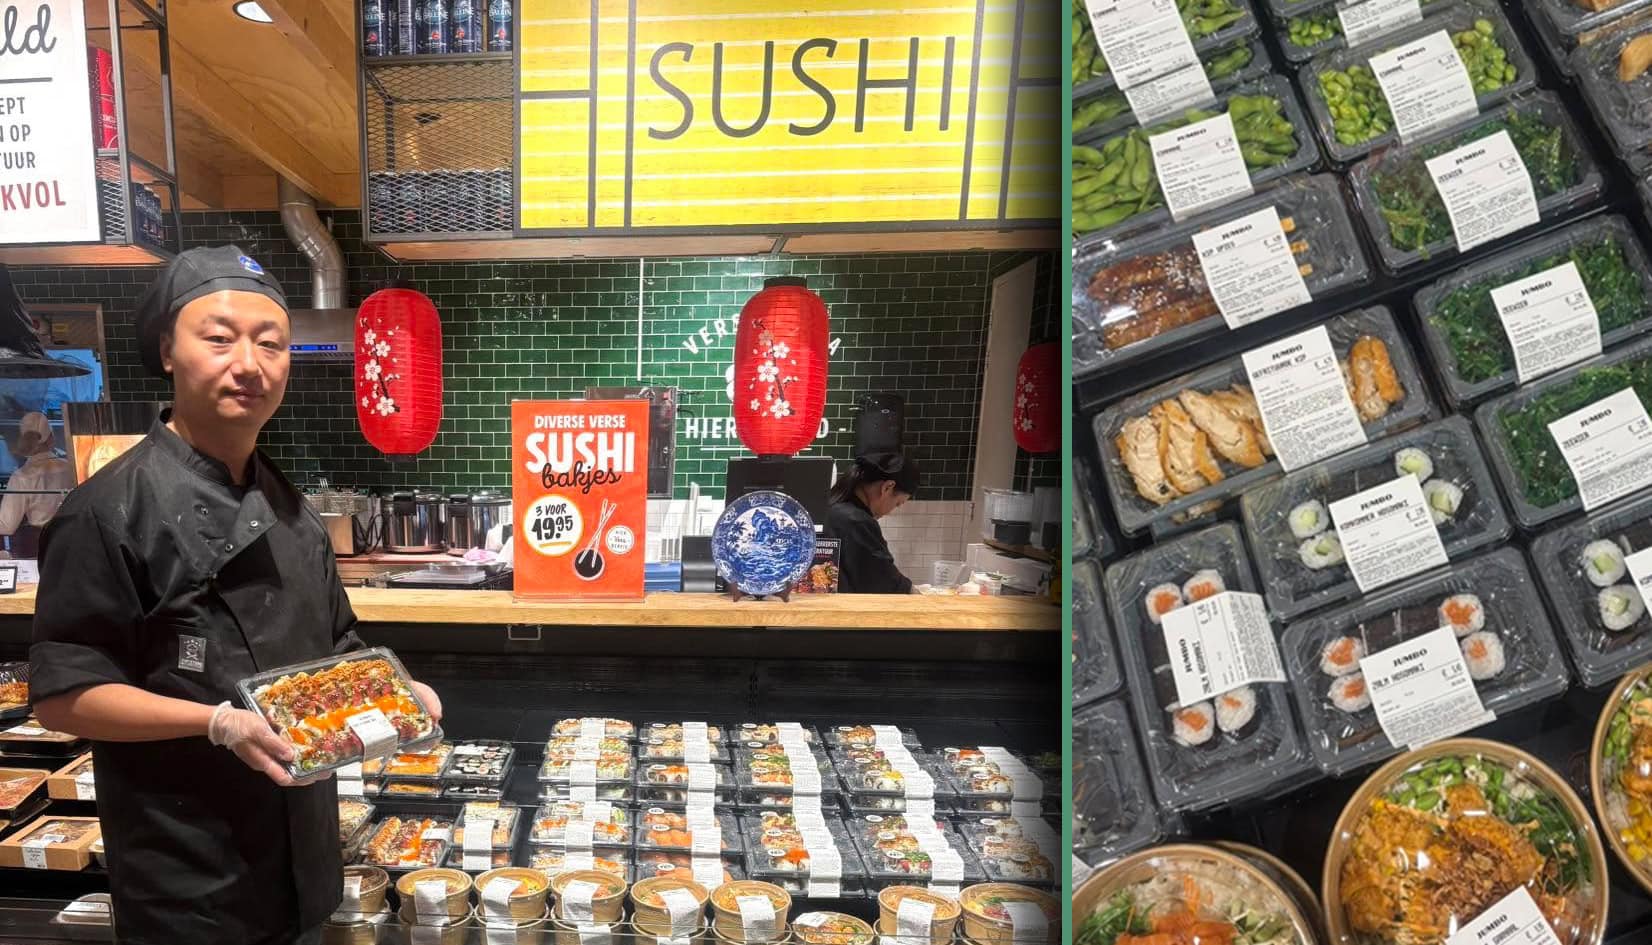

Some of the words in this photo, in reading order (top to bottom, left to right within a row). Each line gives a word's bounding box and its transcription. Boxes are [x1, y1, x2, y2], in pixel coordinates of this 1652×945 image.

[648, 36, 956, 140] SUSHI
[10, 124, 31, 142] OP
[534, 415, 585, 429] DIVERSE
[589, 414, 626, 429] VERSE
[525, 431, 635, 473] SUSHI
[541, 460, 622, 495] bakjes
[535, 505, 543, 517] 3
[545, 503, 567, 516] VOOR
[1393, 647, 1428, 668] JUMBO
